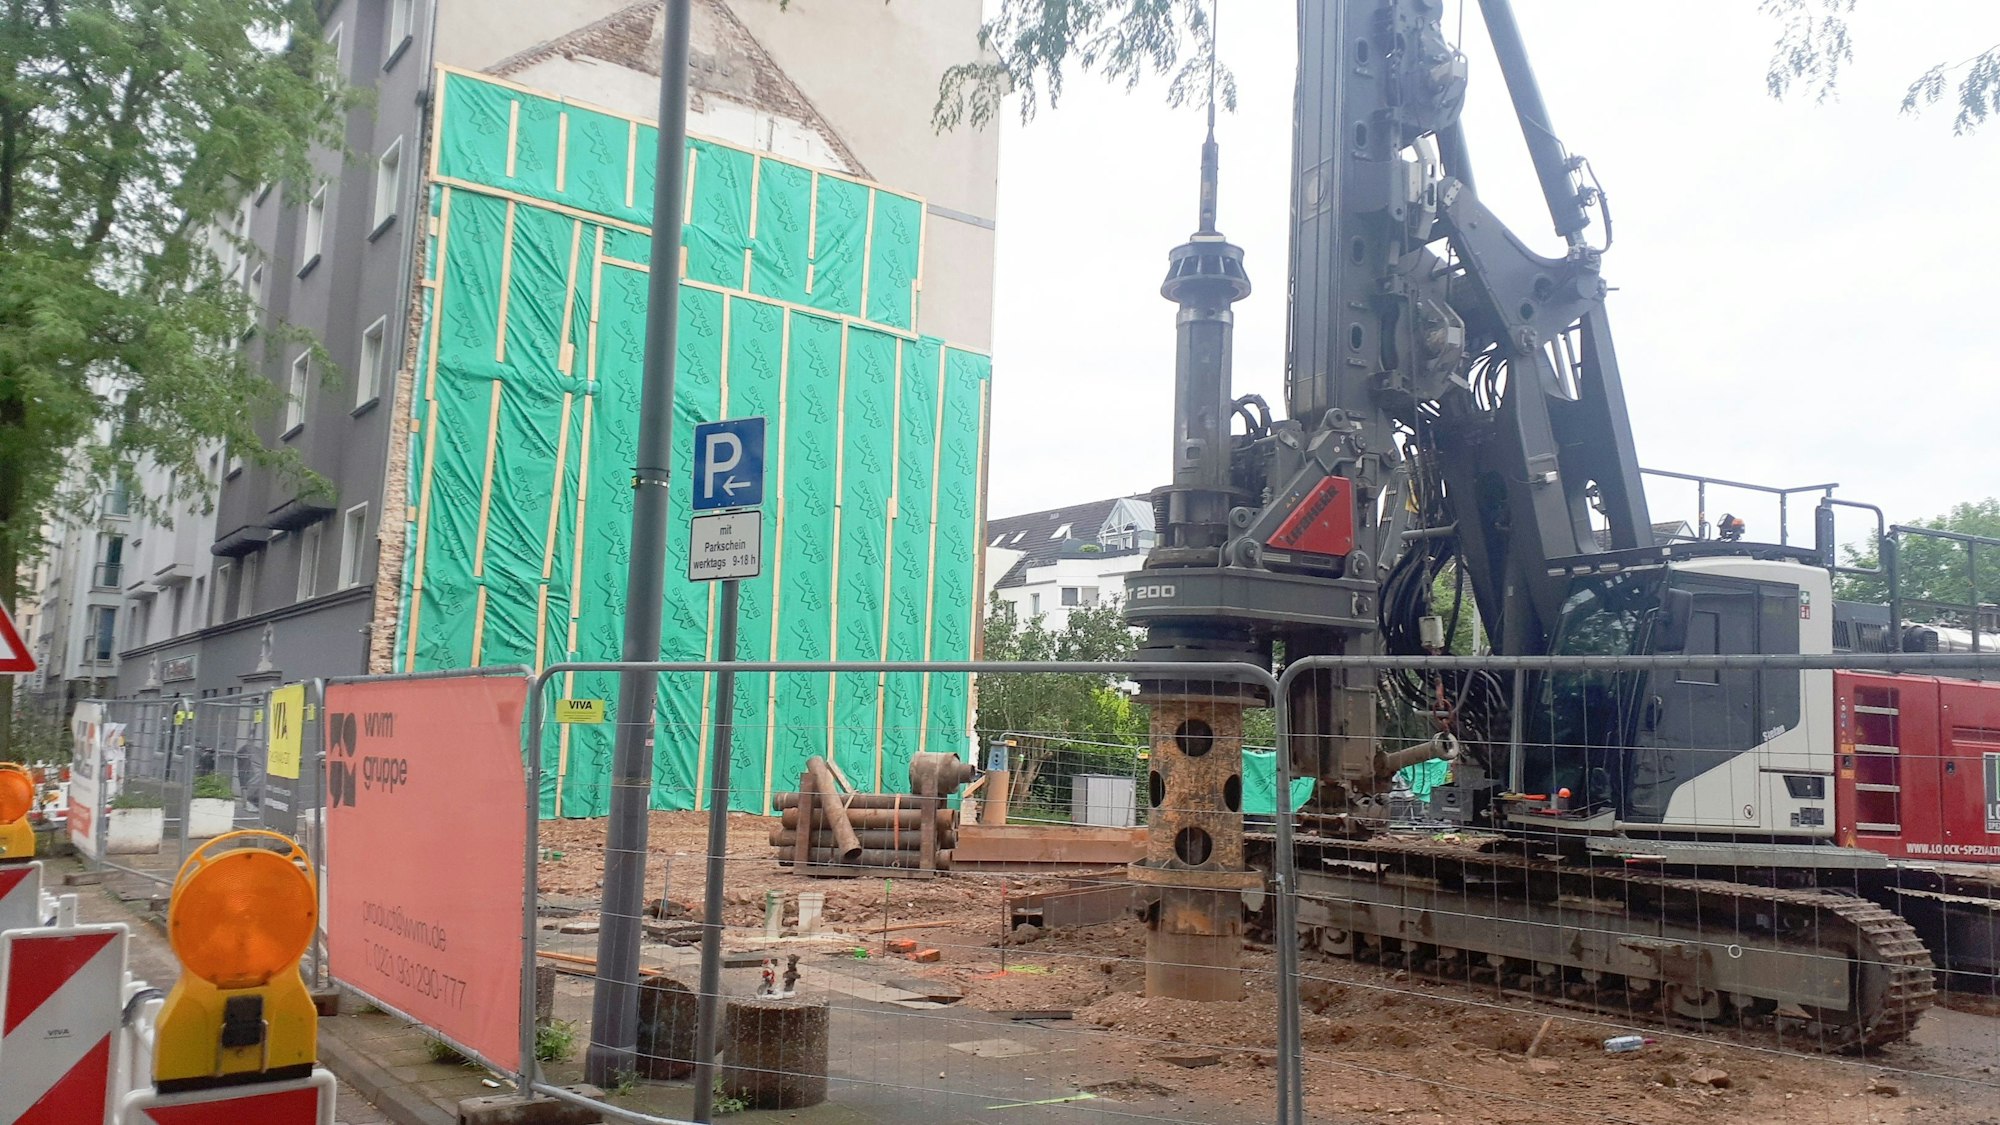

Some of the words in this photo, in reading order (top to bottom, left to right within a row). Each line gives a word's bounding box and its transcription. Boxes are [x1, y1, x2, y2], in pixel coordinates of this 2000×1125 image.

[703, 431, 743, 499] P
[719, 524, 732, 536] mit
[704, 539, 746, 553] Parkschein
[693, 557, 726, 571] werktags
[732, 555, 749, 567] 9-18
[750, 554, 756, 565] h
[1136, 584, 1176, 600] 200
[568, 700, 593, 710] VIVA
[363, 711, 394, 738] wvm
[1762, 724, 1786, 742] Stefan
[363, 755, 408, 794] gruppe
[362, 899, 447, 952] product@wvm.de
[47, 1028, 70, 1036] VIVA
